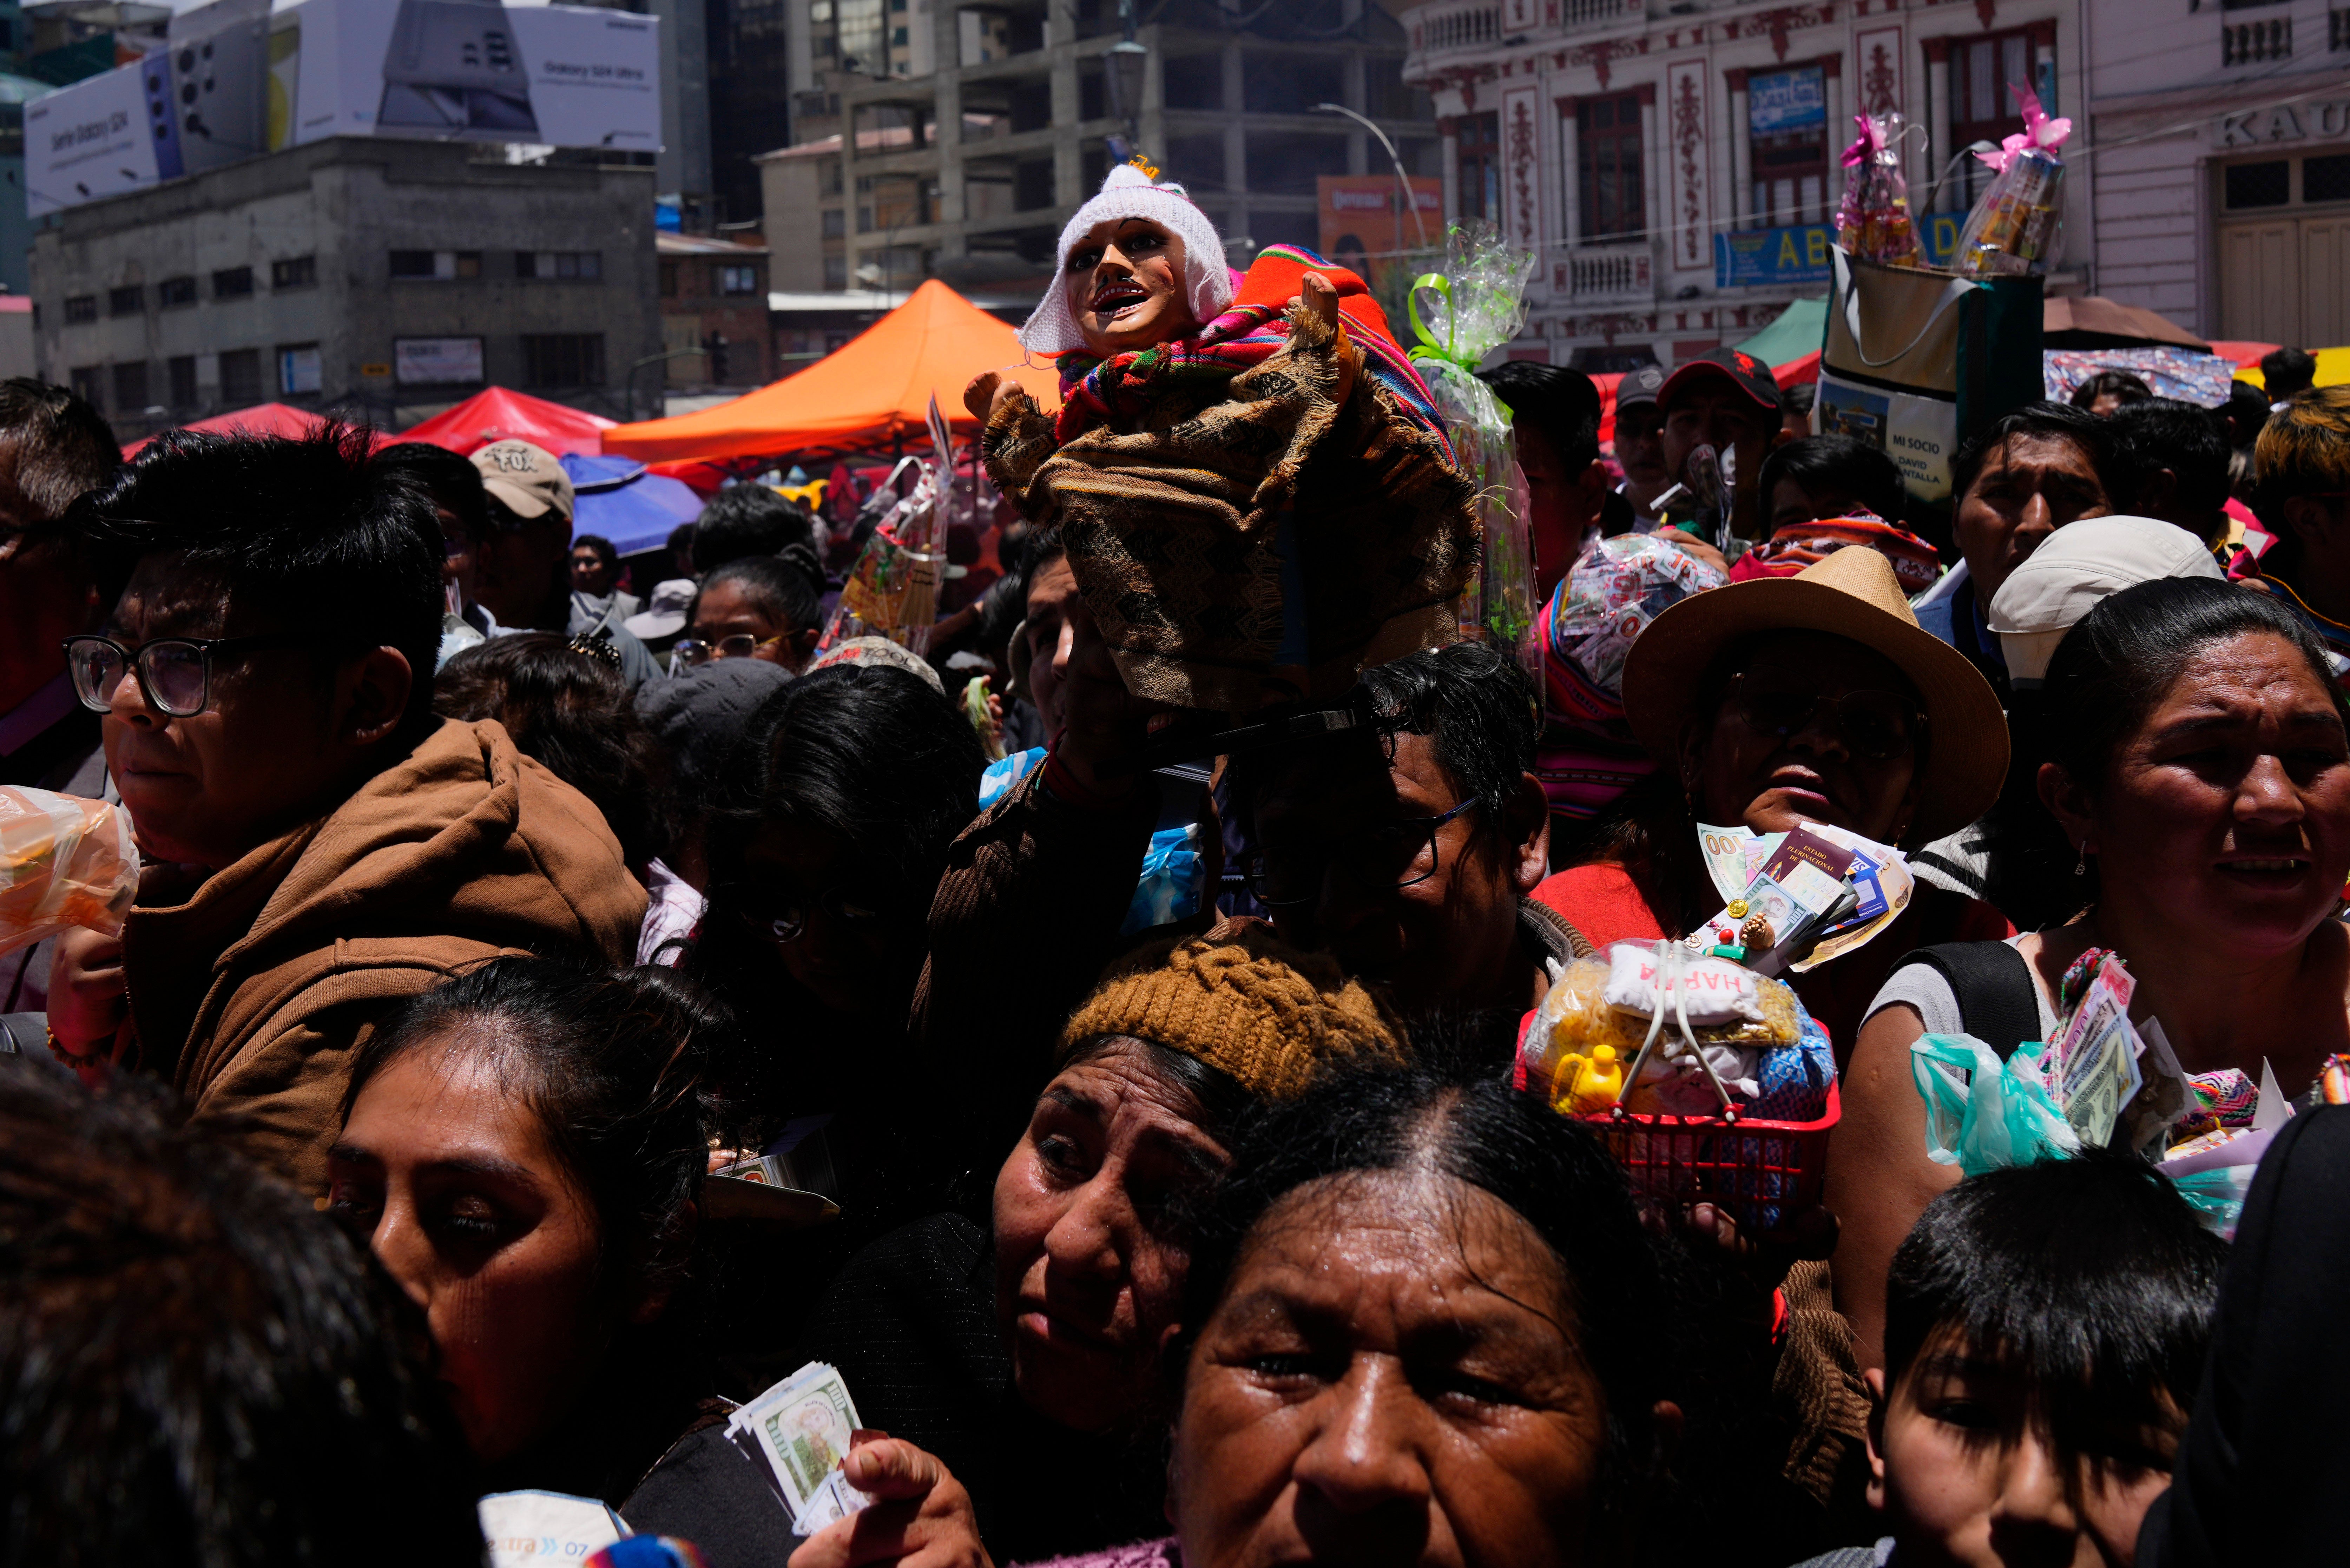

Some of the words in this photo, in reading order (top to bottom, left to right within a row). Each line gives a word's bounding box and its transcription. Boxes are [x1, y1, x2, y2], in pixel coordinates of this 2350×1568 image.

[1893, 435, 1905, 447] MI
[1908, 437, 1940, 454] SOCIO
[496, 452, 539, 473] FOX
[1898, 456, 1927, 470] DAVID
[1787, 845, 1835, 872] PLURINACIONAL
[1803, 845, 1827, 859] ESTADO
